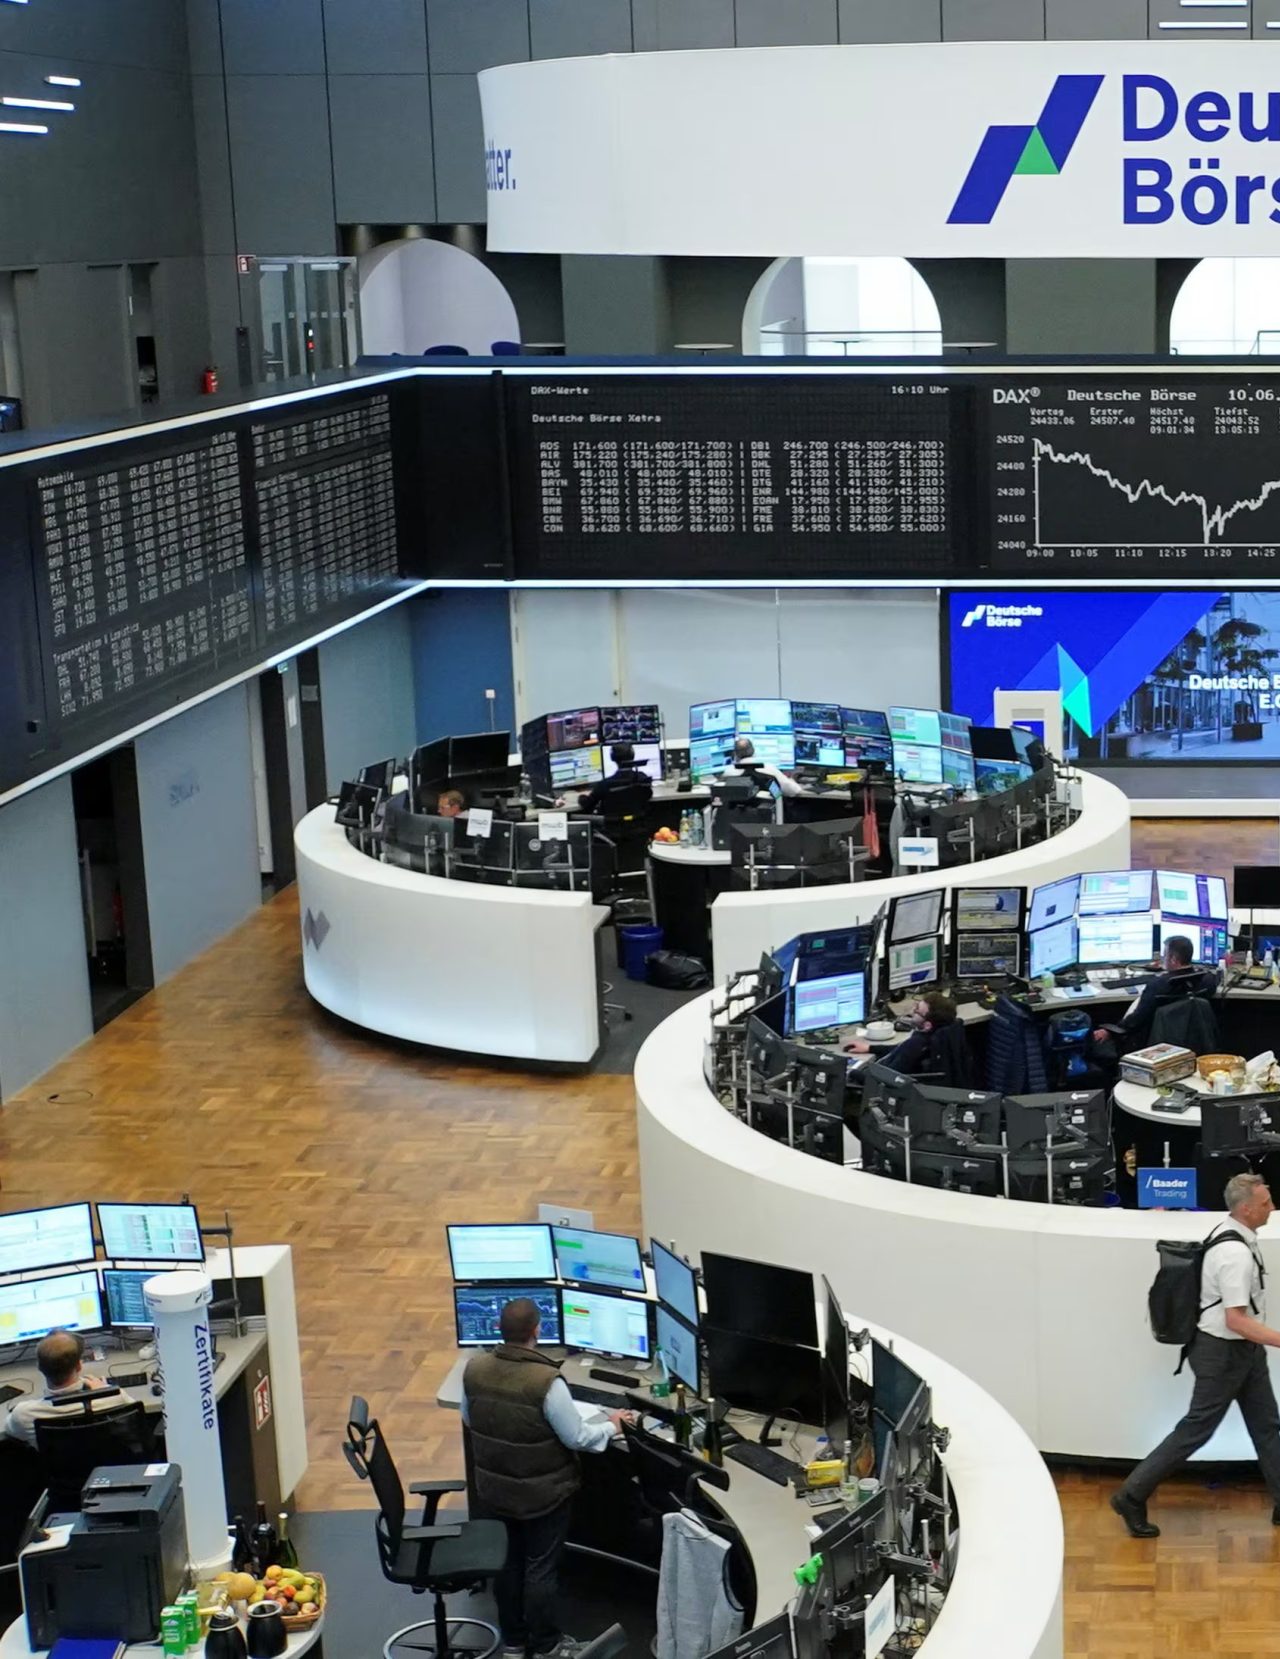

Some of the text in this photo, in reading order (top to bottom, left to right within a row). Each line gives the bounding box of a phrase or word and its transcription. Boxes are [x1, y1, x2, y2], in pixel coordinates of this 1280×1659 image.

[1068, 390, 1141, 400] Deutsche
[1151, 389, 1196, 400] Börse
[986, 605, 1042, 616] Deutsche
[986, 616, 1022, 627] Börse
[1189, 675, 1269, 690] Deutsche
[1153, 1179, 1188, 1187] Baader
[194, 1323, 215, 1430] Zertifikate
